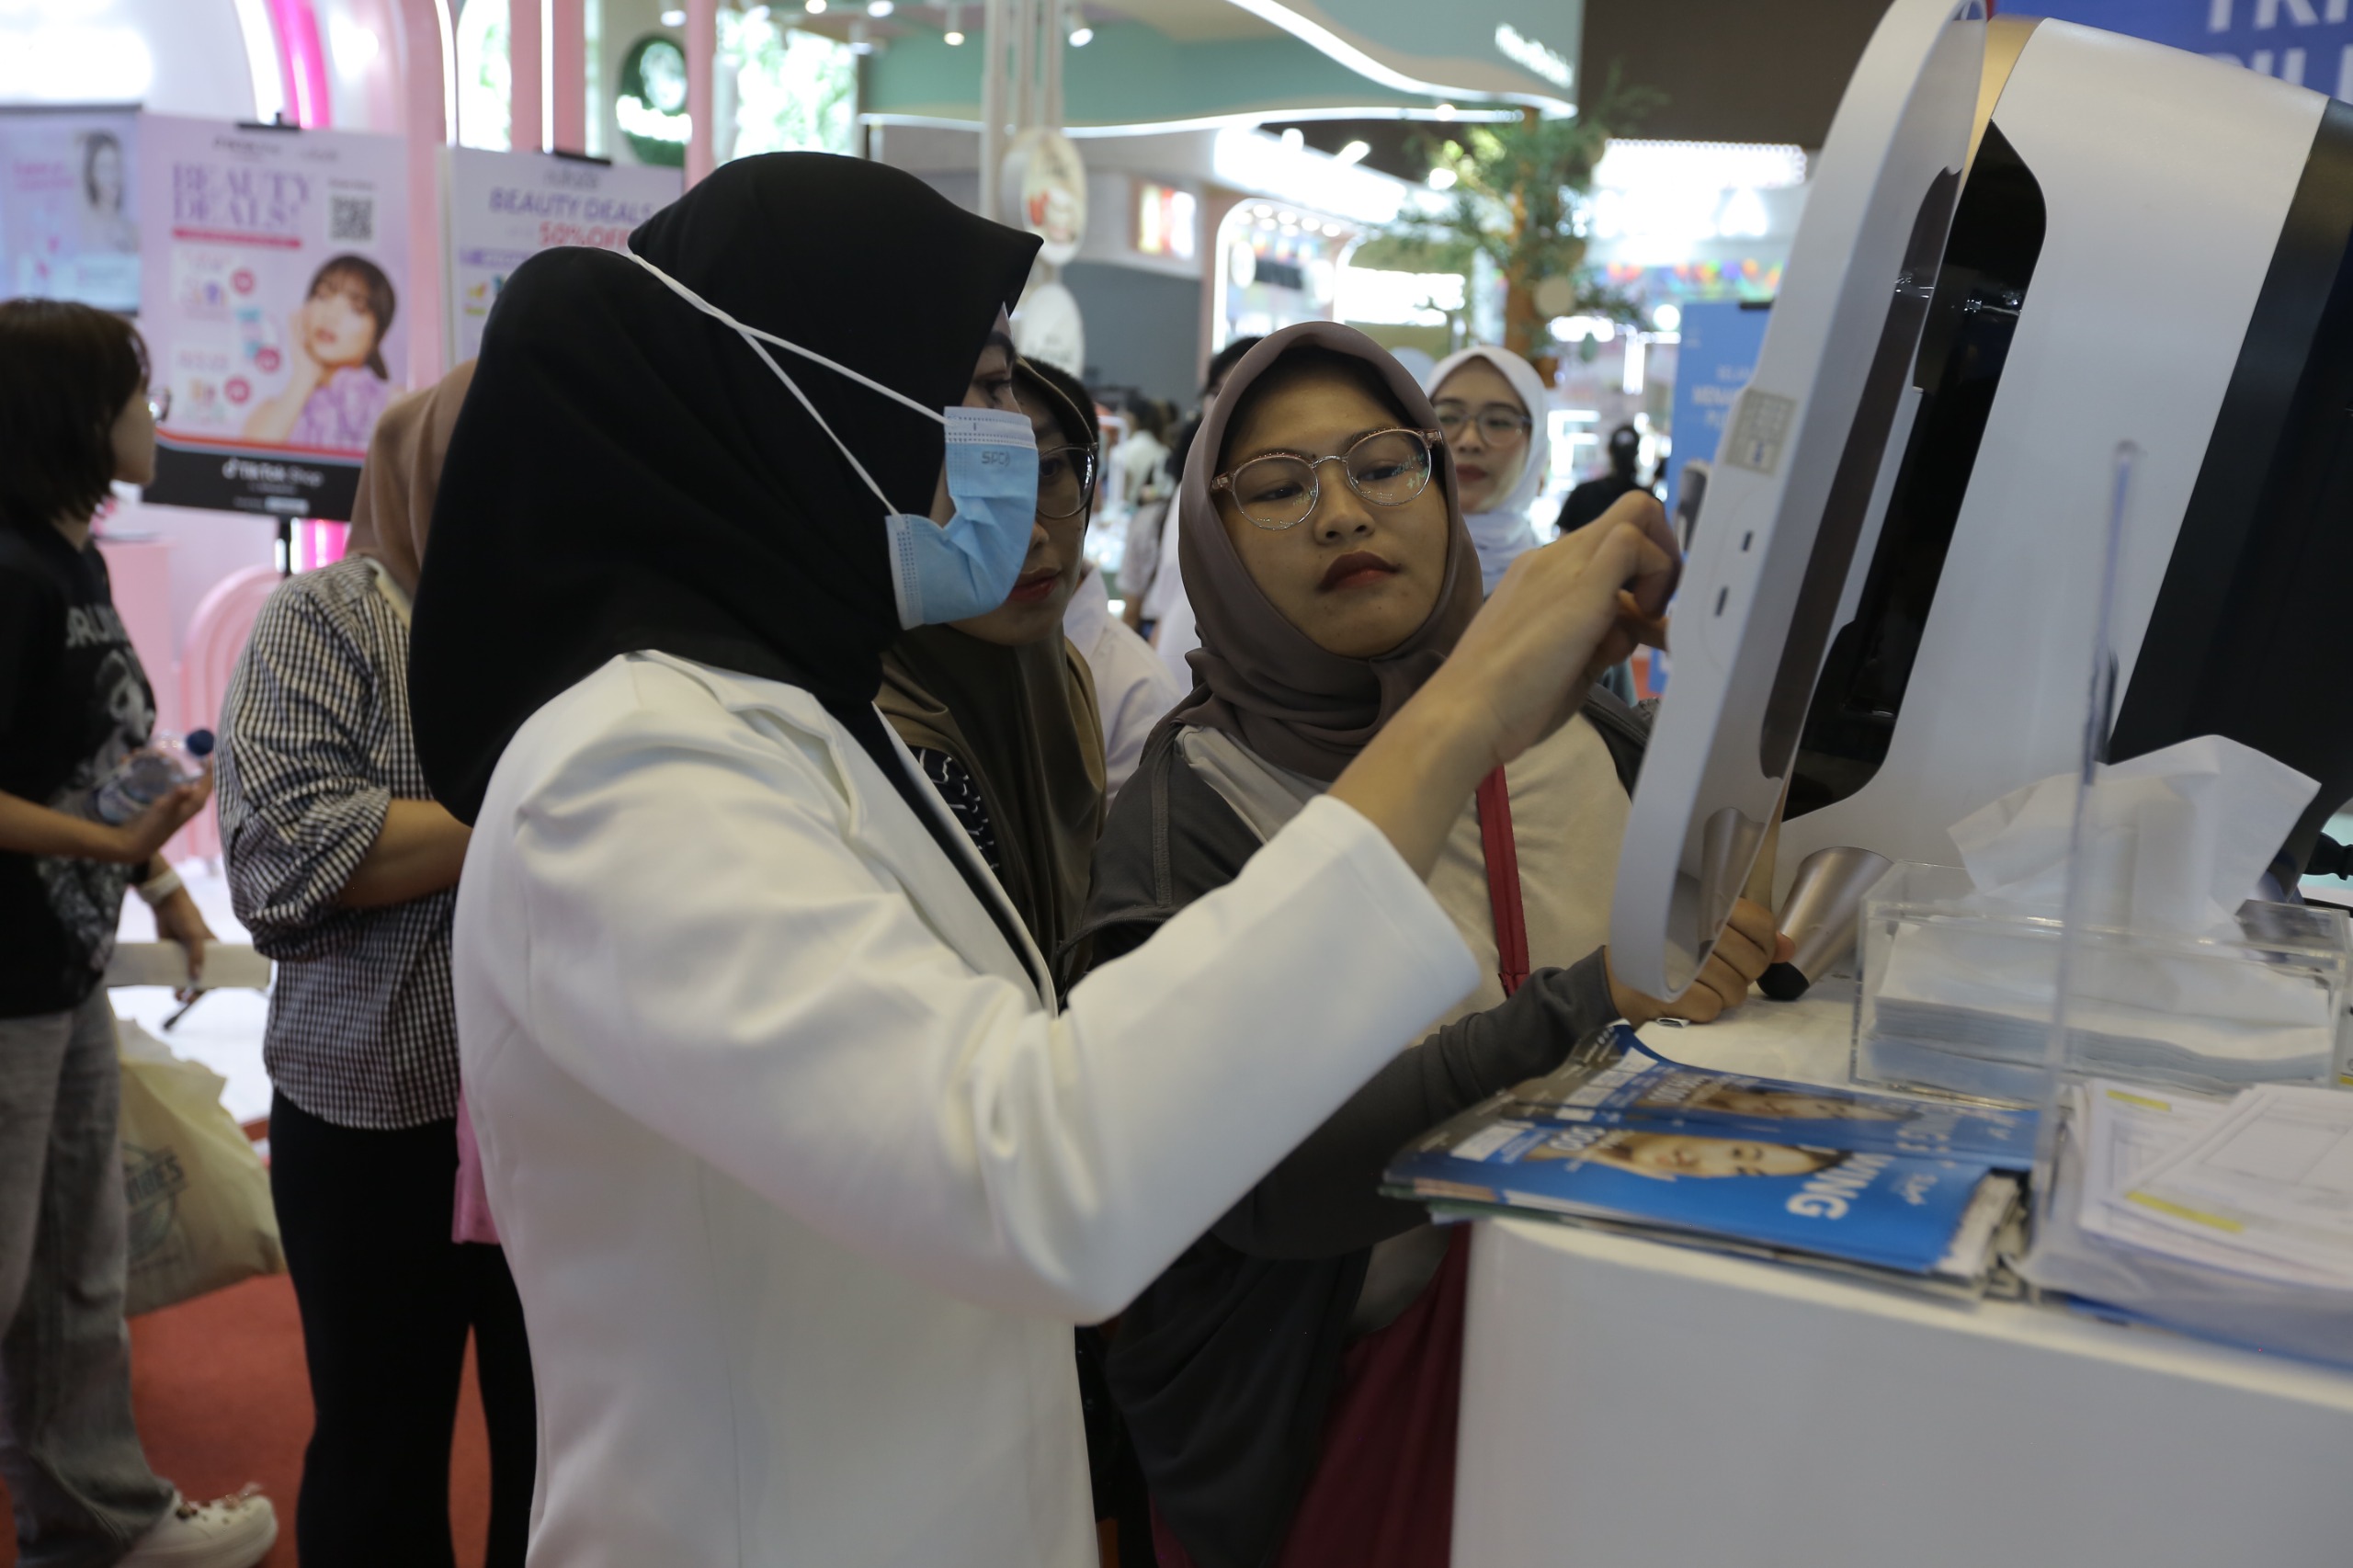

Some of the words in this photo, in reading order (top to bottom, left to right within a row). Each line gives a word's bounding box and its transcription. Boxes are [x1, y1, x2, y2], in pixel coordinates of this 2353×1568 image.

[173, 161, 316, 204] BEAUTY
[490, 187, 581, 218] BEAUTY
[287, 465, 325, 488] Shop
